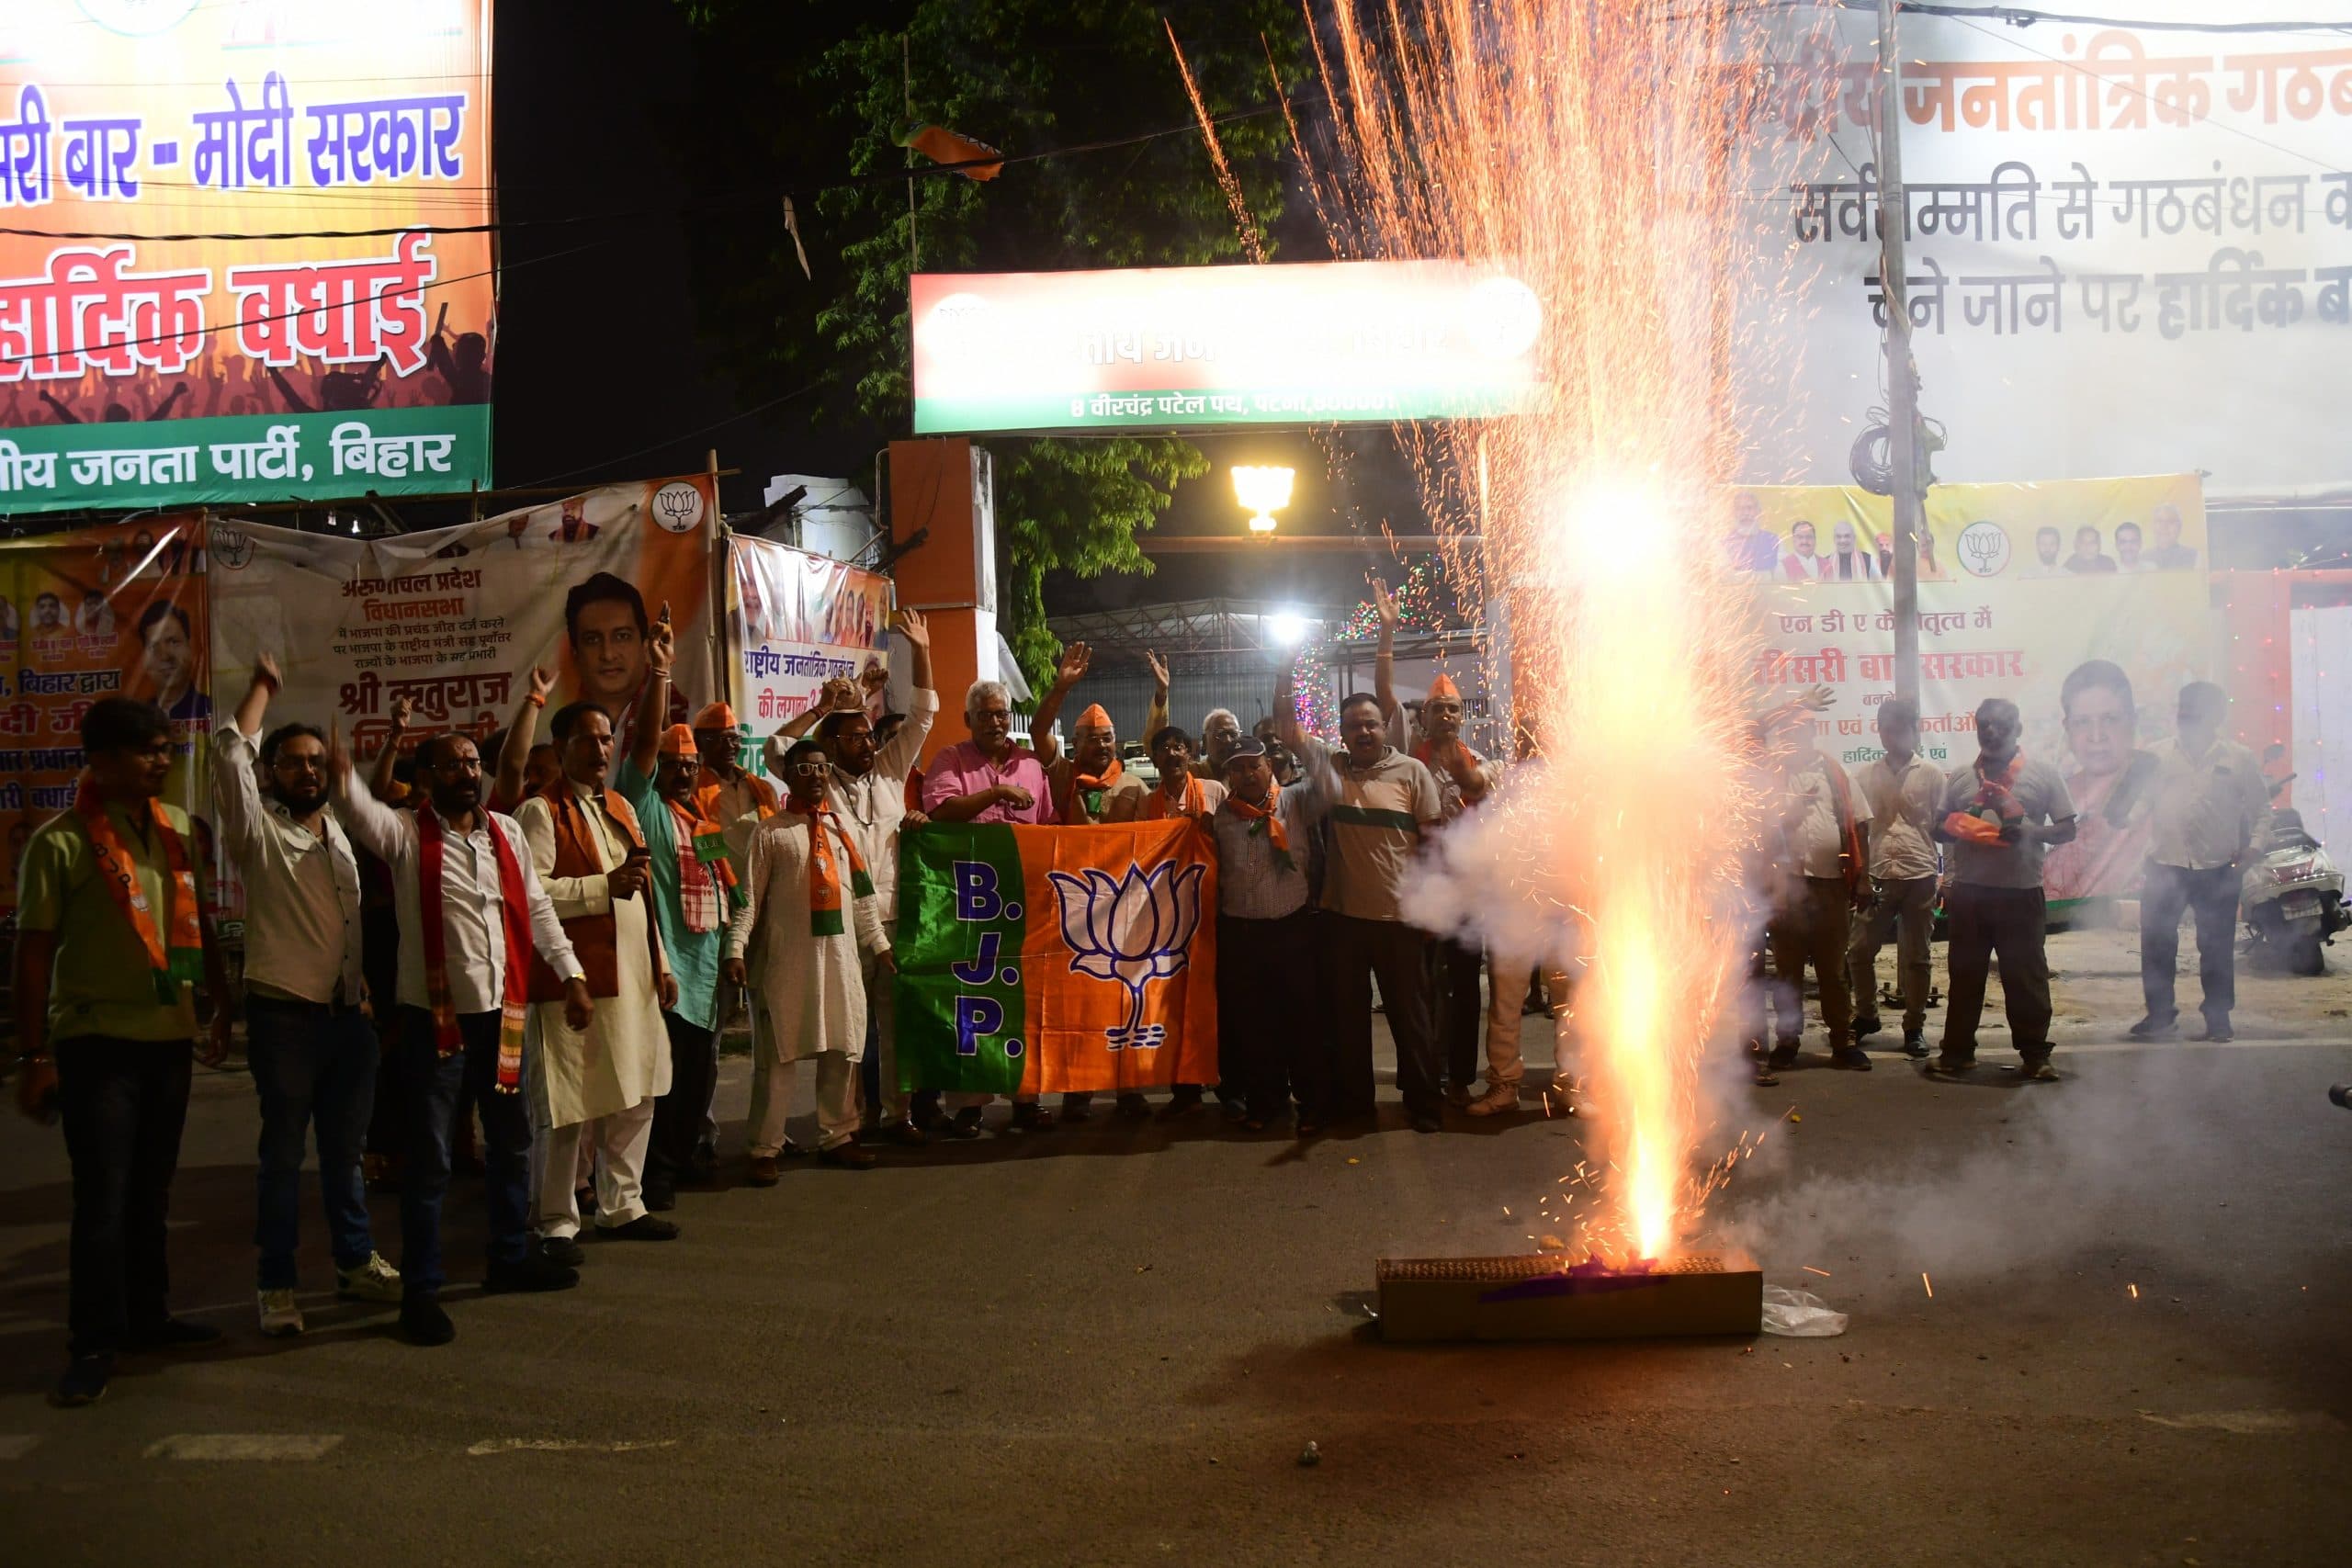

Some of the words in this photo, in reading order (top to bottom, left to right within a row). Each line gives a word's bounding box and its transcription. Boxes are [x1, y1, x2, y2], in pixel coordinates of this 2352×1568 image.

[1900, 30, 2213, 132] जनतांत्रिक
[63, 119, 141, 197] बार
[194, 71, 293, 188] मोदी
[307, 96, 465, 187] सरकार
[2052, 162, 2098, 240] से
[2109, 159, 2310, 239] गठबंधन
[232, 232, 433, 375] बधाई
[1960, 256, 2065, 334] जाने
[2076, 273, 2143, 333] पर
[2155, 246, 2307, 340] हार्दिक
[1157, 391, 1204, 415] पटेल
[66, 446, 199, 486] जनता
[210, 425, 314, 483] पार्टी,
[330, 423, 457, 477] बिहार
[342, 575, 432, 597] अरुणाचल
[435, 567, 482, 591] प्रदेश
[364, 599, 464, 622] विधानसभा
[1780, 615, 1814, 634] एन
[1821, 609, 1845, 633] डी
[1853, 613, 1867, 632] ए
[349, 627, 382, 640] भाजपा
[385, 623, 401, 637] की
[434, 621, 455, 634] जीत
[348, 643, 382, 655] भाजपा
[385, 639, 396, 653] के
[384, 654, 397, 667] के
[399, 653, 433, 666] भाजपा
[19, 670, 75, 694] बिहार
[80, 671, 121, 694] द्वारा
[340, 671, 381, 714] श्री
[758, 688, 775, 718] की
